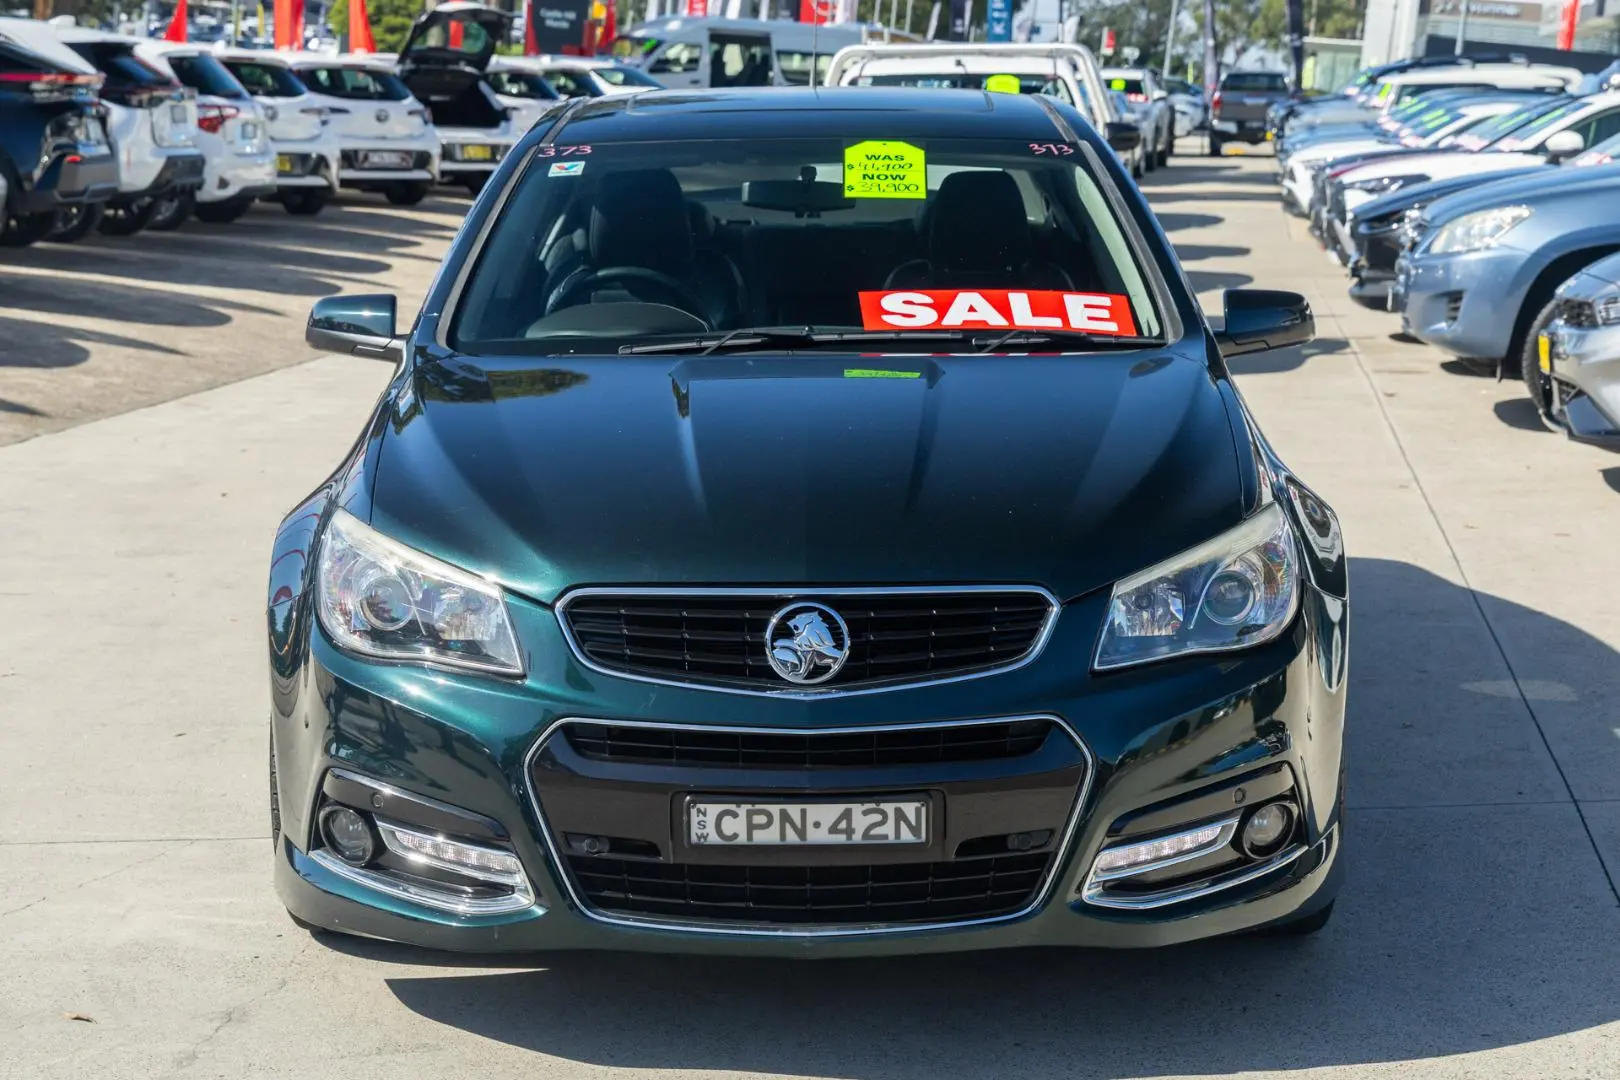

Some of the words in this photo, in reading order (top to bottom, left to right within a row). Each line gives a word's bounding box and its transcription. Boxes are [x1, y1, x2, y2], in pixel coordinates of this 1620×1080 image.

[538, 145, 592, 158] 373
[1029, 143, 1074, 155] 373
[880, 292, 1118, 331] SALE
